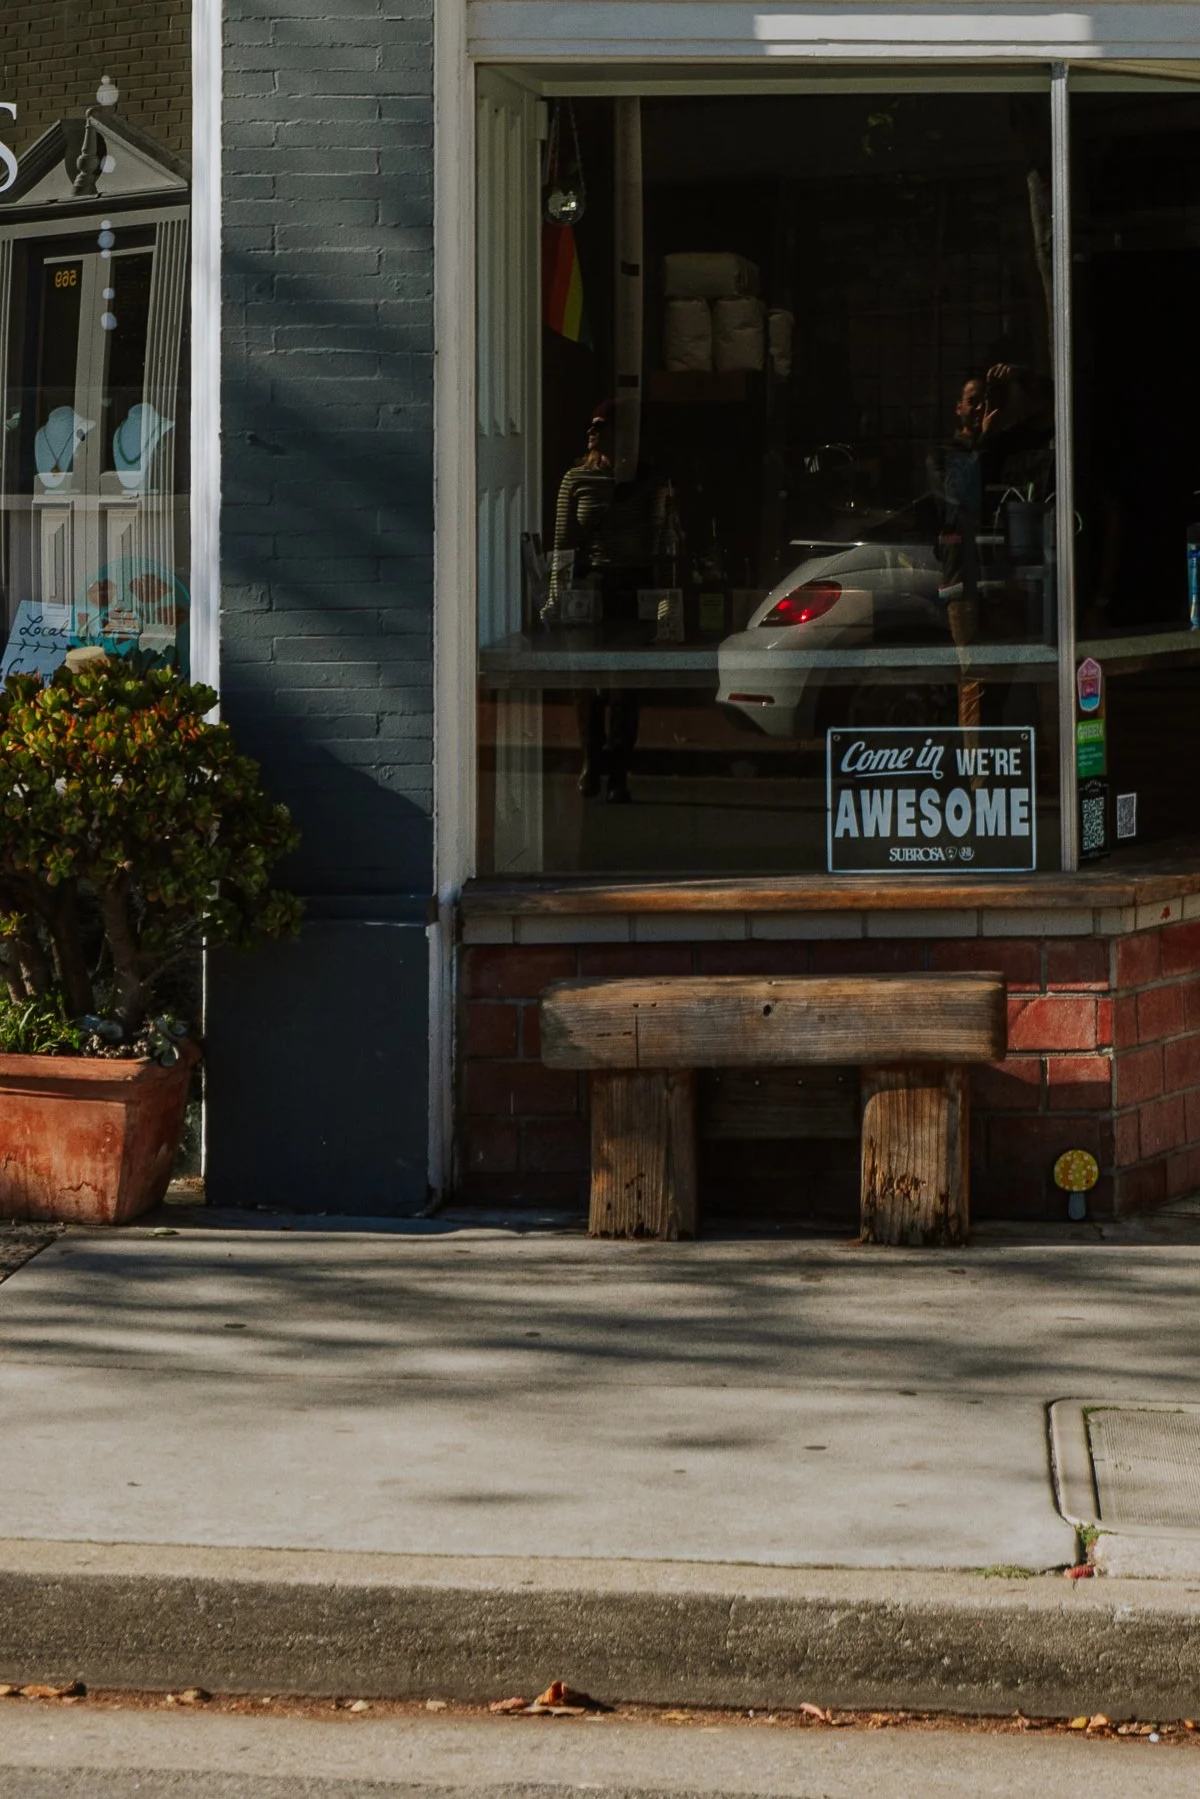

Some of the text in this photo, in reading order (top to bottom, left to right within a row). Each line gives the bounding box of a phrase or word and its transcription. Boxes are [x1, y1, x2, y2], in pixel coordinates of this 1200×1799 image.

[19, 613, 70, 638] Local
[840, 738, 1022, 780] Come in WE'RE
[834, 787, 1030, 839] AWESOME
